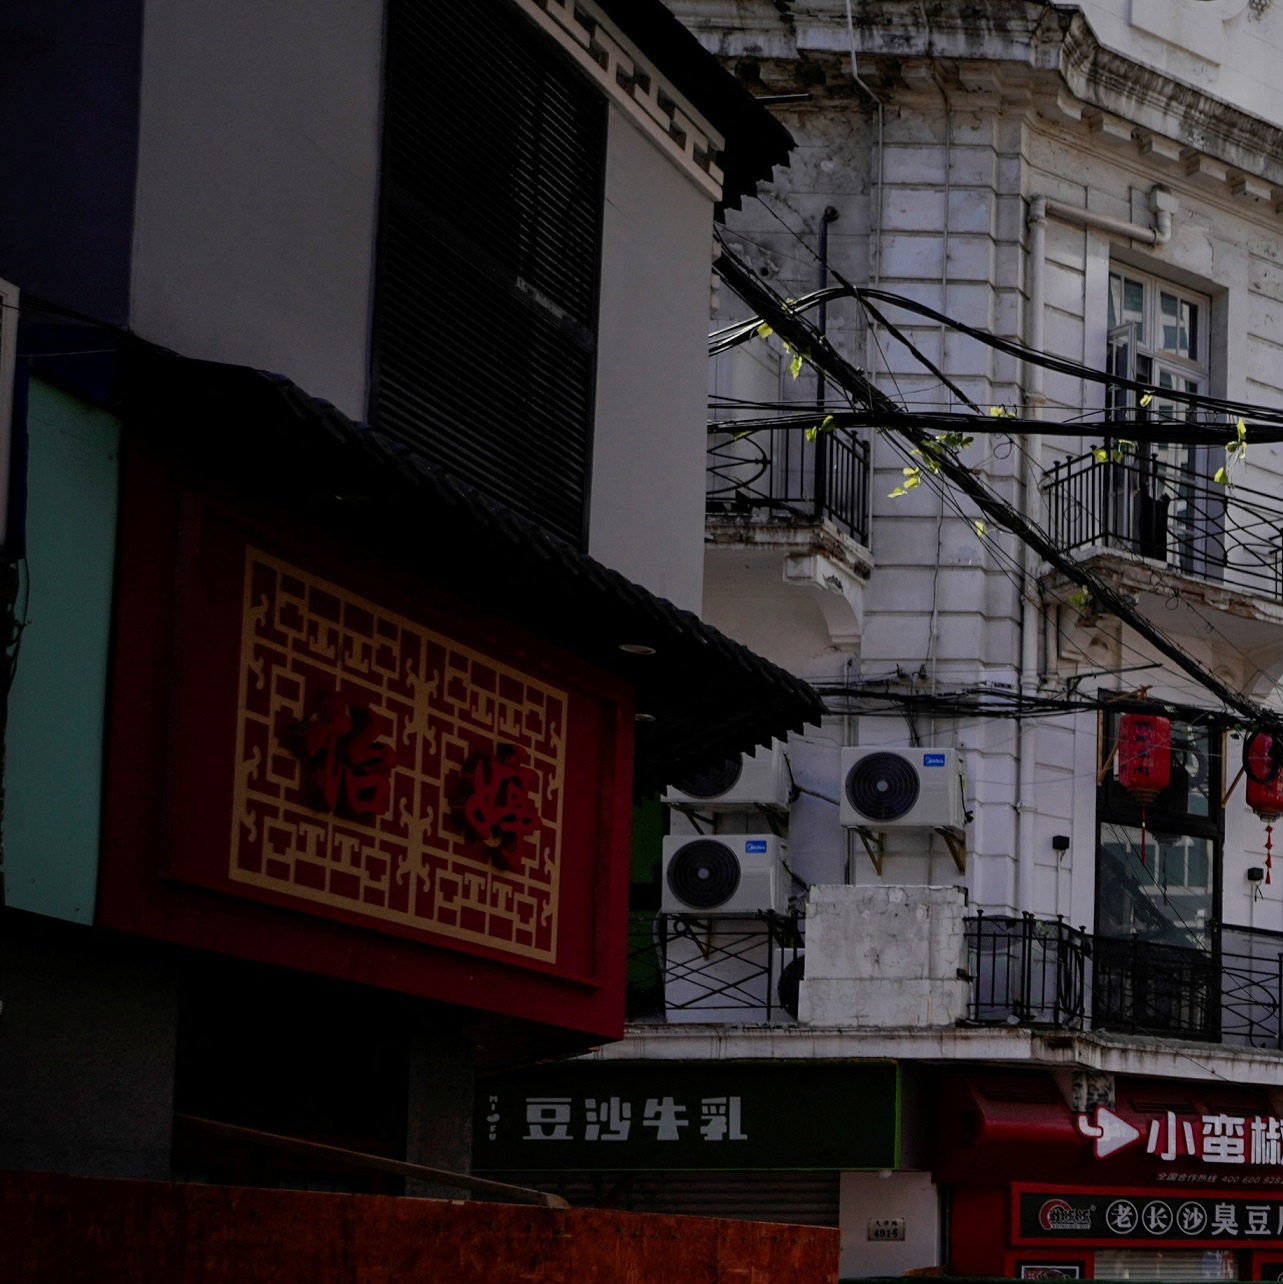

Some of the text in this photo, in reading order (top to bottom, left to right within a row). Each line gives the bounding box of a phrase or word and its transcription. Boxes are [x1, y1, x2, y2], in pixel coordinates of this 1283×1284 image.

[522, 1096, 749, 1142] 豆沙牛乳
[1156, 1172, 1219, 1183] 全国合作热线
[1221, 1175, 1240, 1184] 400
[1242, 1176, 1261, 1185] 600
